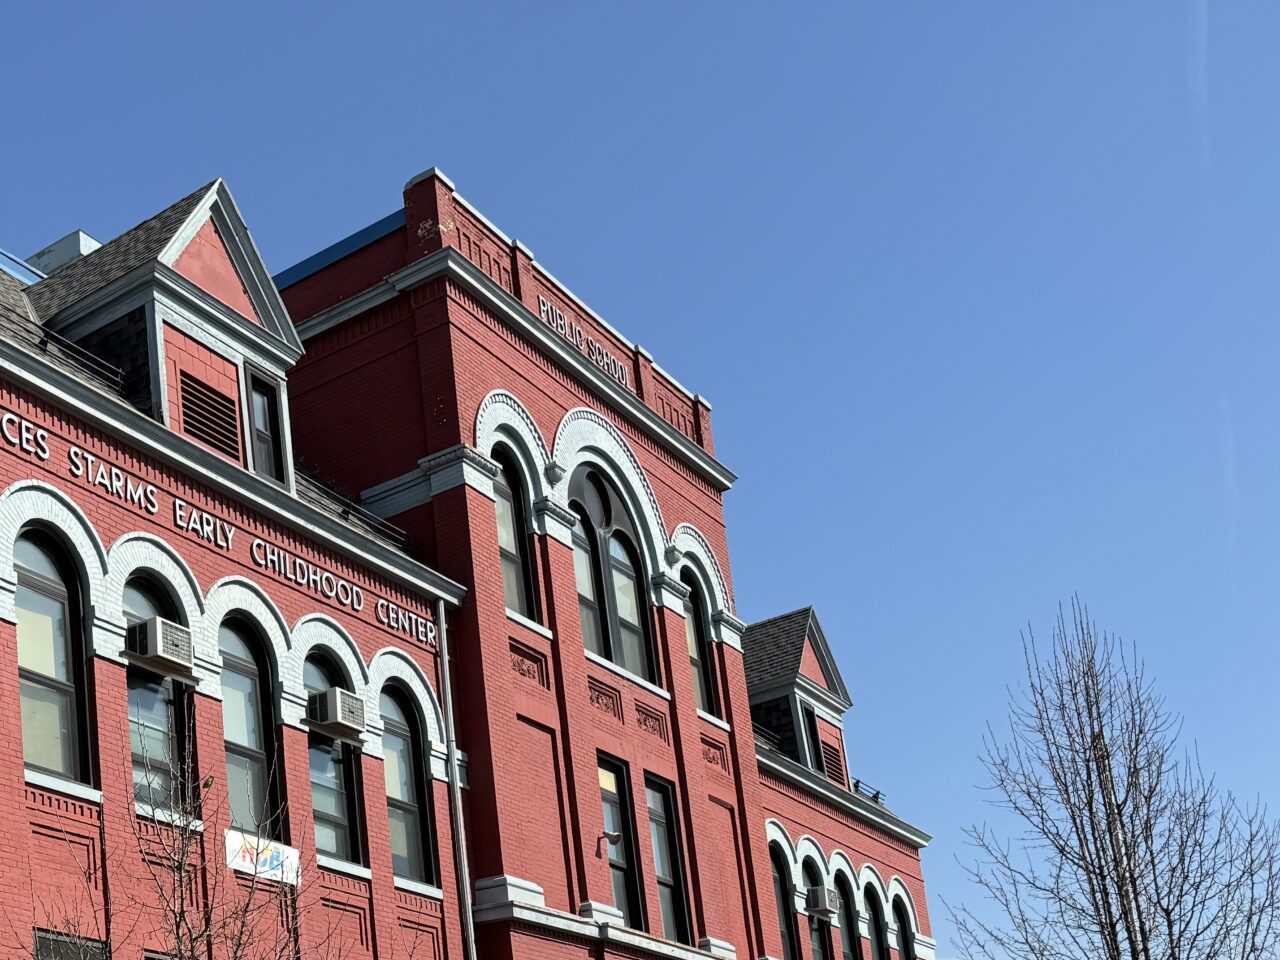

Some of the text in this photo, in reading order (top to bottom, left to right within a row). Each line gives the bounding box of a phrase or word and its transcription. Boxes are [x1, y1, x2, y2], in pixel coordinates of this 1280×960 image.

[538, 294, 636, 394] PUBLIC SCHOOL
[70, 446, 159, 514] STARMS
[175, 499, 236, 550] EARLY
[252, 538, 364, 612] CHILDHOOD
[376, 599, 437, 646] CENTER
